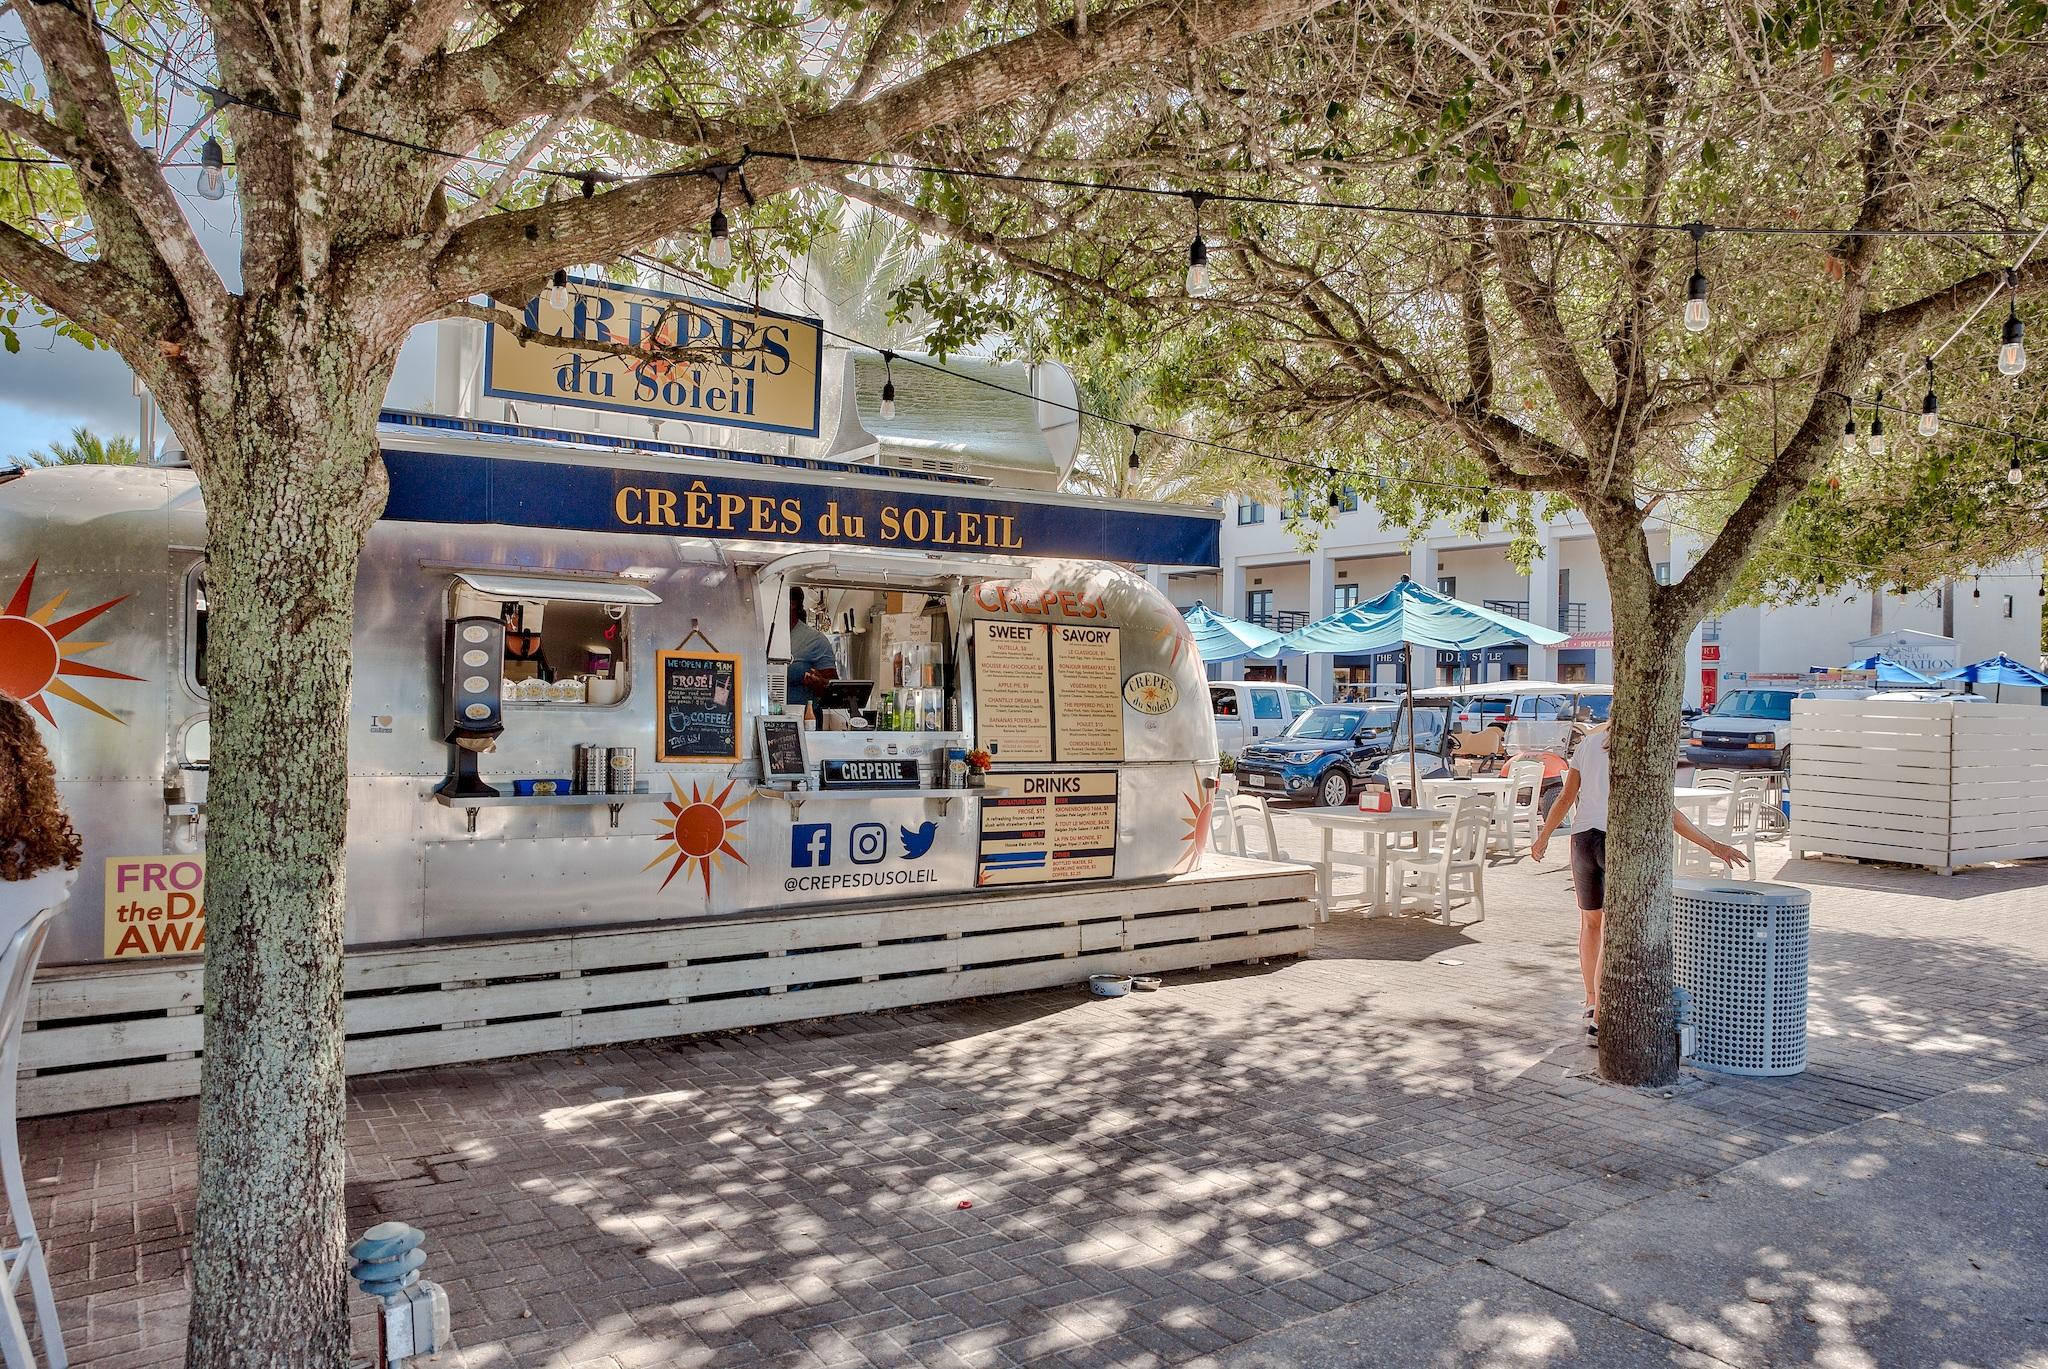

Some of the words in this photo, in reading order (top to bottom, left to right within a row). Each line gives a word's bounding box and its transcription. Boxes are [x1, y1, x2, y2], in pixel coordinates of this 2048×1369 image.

[522, 287, 791, 376] CRÊPES
[556, 353, 615, 398] du
[633, 364, 756, 416] Soleil
[614, 480, 803, 535] CRÊPES
[818, 502, 866, 538] du
[880, 507, 1023, 549] SOLEIL
[989, 625, 1032, 640] SWEET
[1062, 629, 1111, 643] SAVORY
[1133, 697, 1143, 709] du
[1146, 698, 1171, 712] Soleil
[690, 712, 732, 725] COFFEE!
[669, 737, 686, 745] TAG
[841, 762, 903, 780] CREPERIE
[1023, 777, 1081, 794] DRINKS
[117, 861, 204, 893] FRO
[784, 869, 938, 892] @CREPESDUSOLEIL
[117, 901, 163, 923] the
